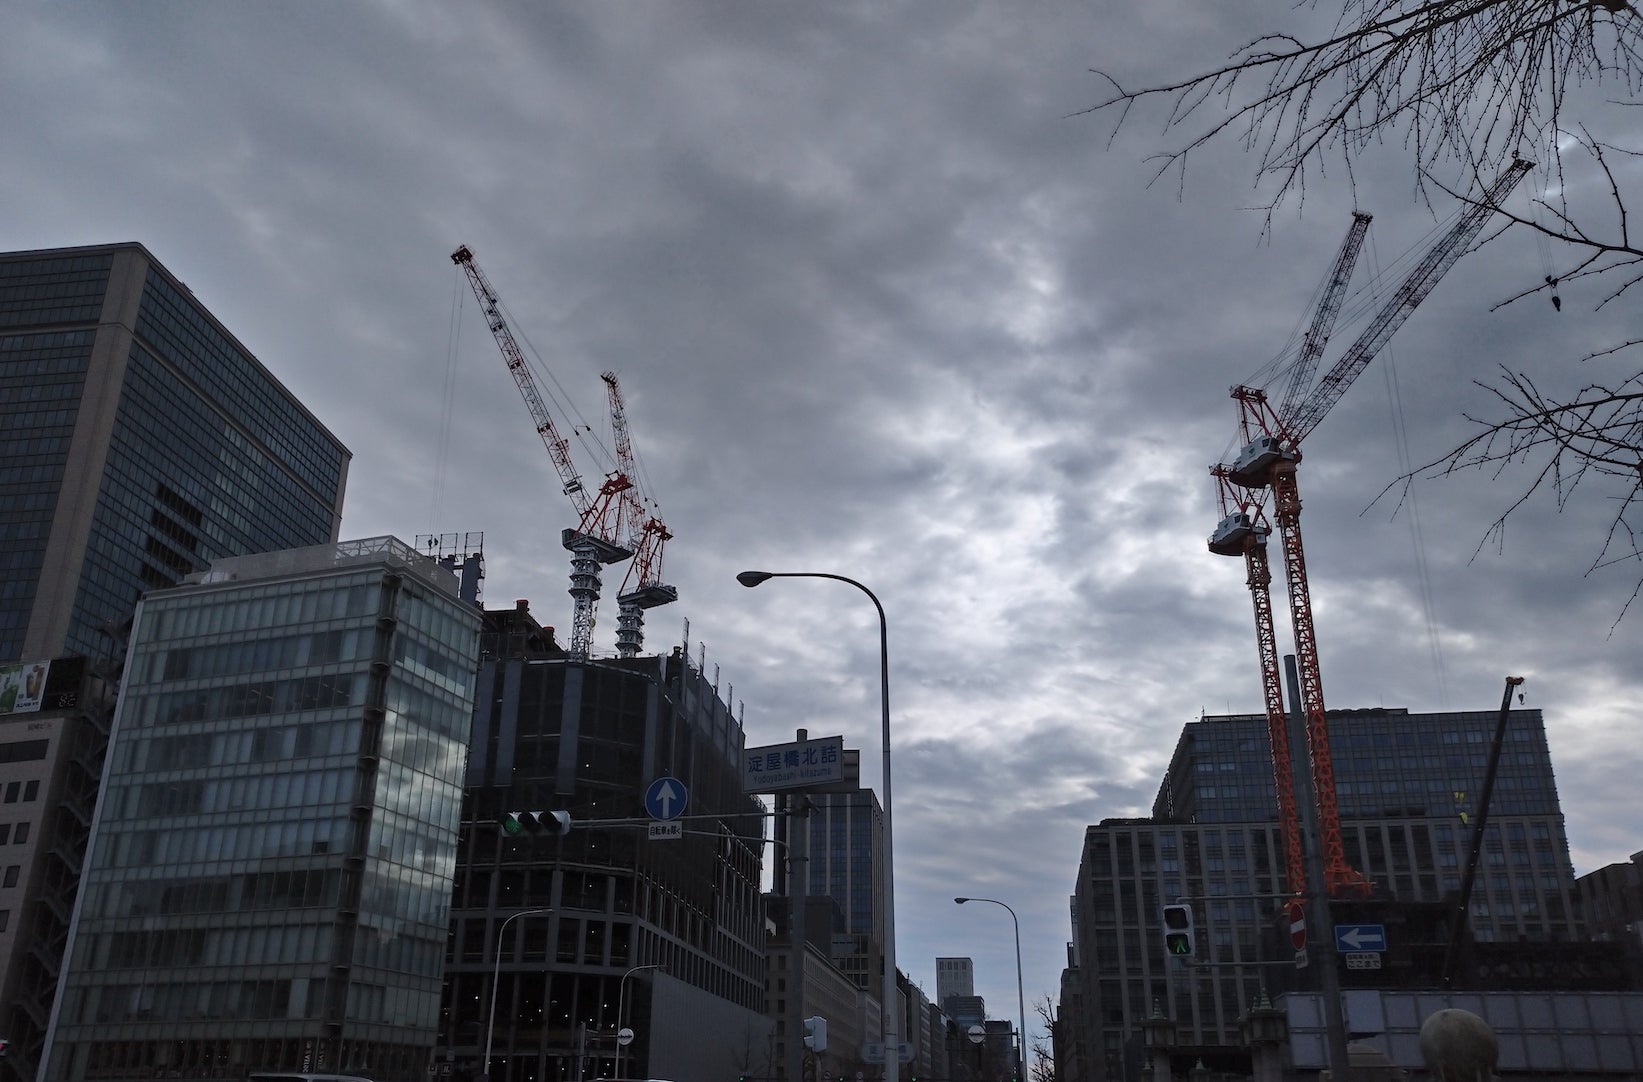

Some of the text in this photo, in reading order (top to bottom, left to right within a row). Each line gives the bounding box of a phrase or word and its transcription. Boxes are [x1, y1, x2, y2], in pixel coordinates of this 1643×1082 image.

[748, 745, 836, 773] 淀屋橋北詰
[1348, 960, 1380, 968] ここまで
